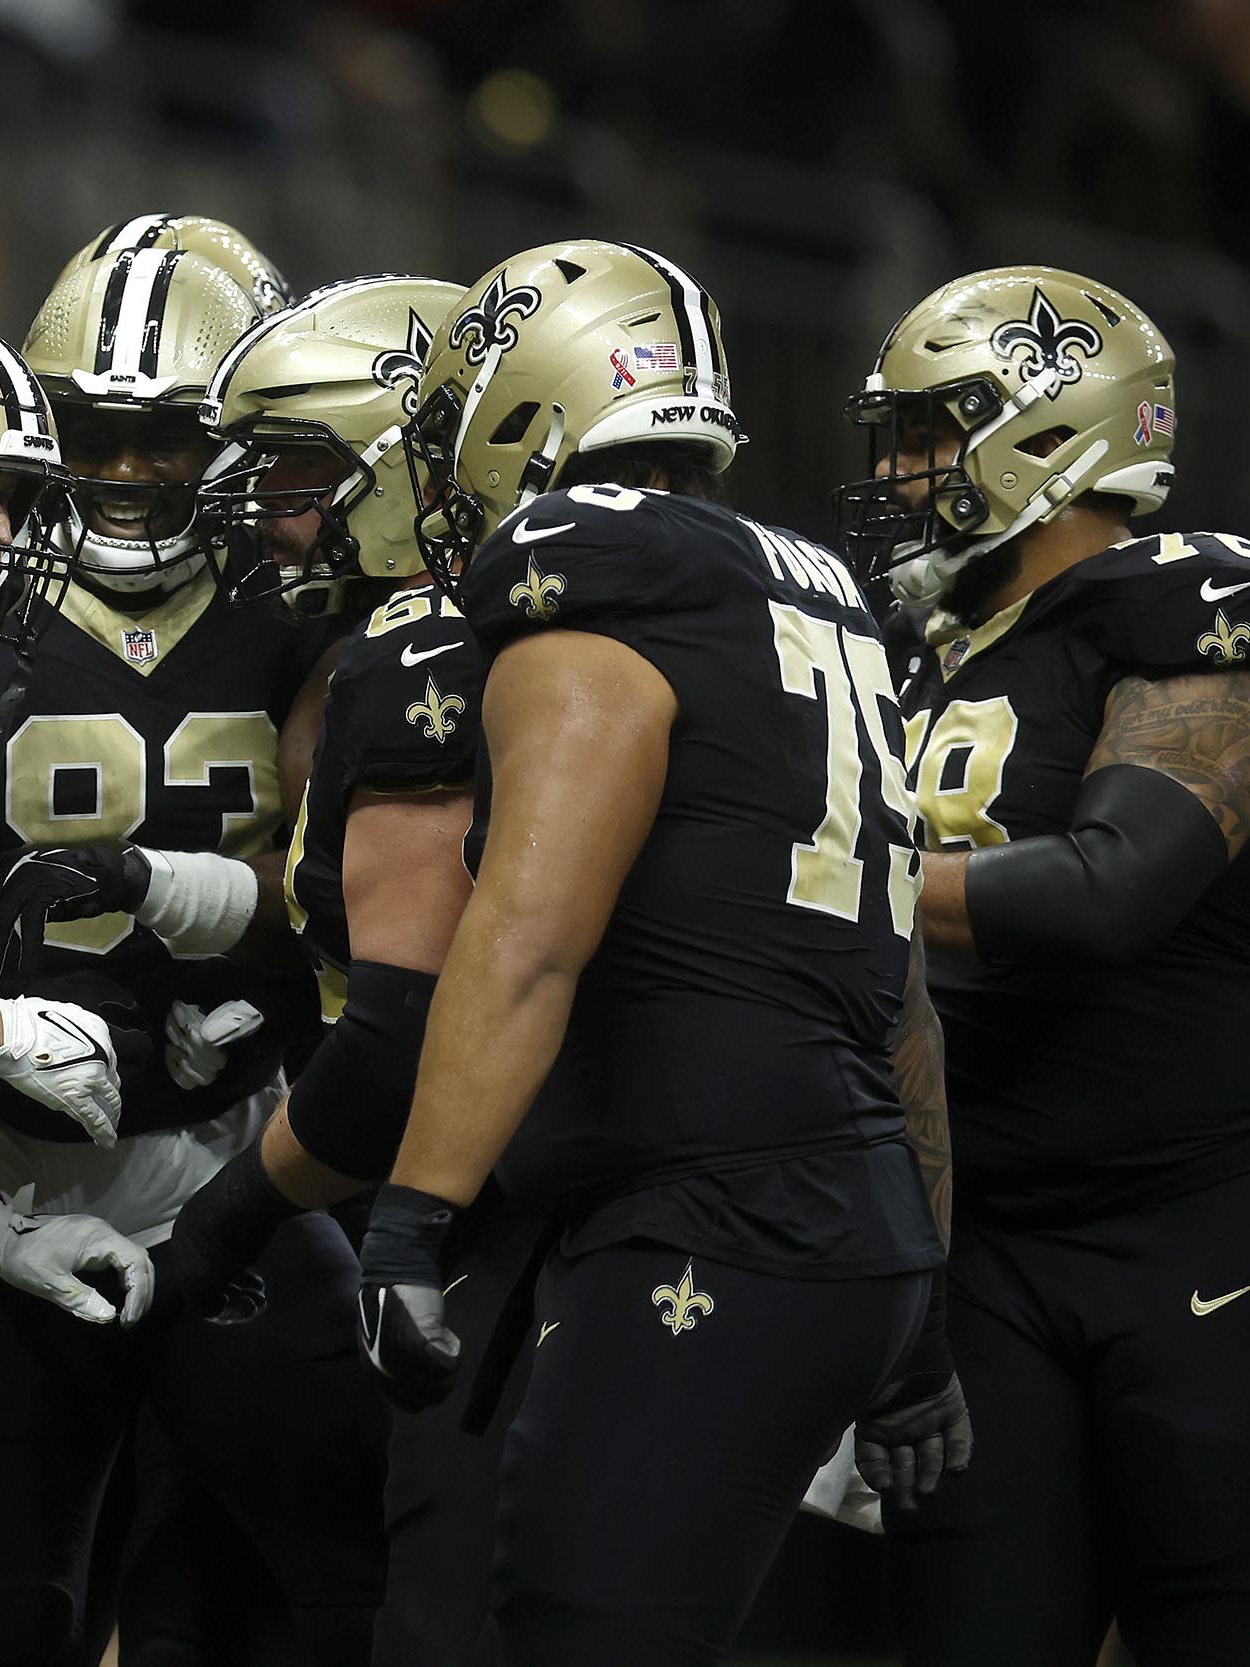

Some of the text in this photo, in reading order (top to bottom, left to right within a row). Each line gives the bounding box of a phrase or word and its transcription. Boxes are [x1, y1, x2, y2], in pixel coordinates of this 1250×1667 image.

[110, 375, 136, 383] SAINTS
[683, 366, 697, 394] 7
[652, 406, 696, 426] NEW
[23, 435, 55, 451] SAINTS
[129, 643, 152, 657] NFL
